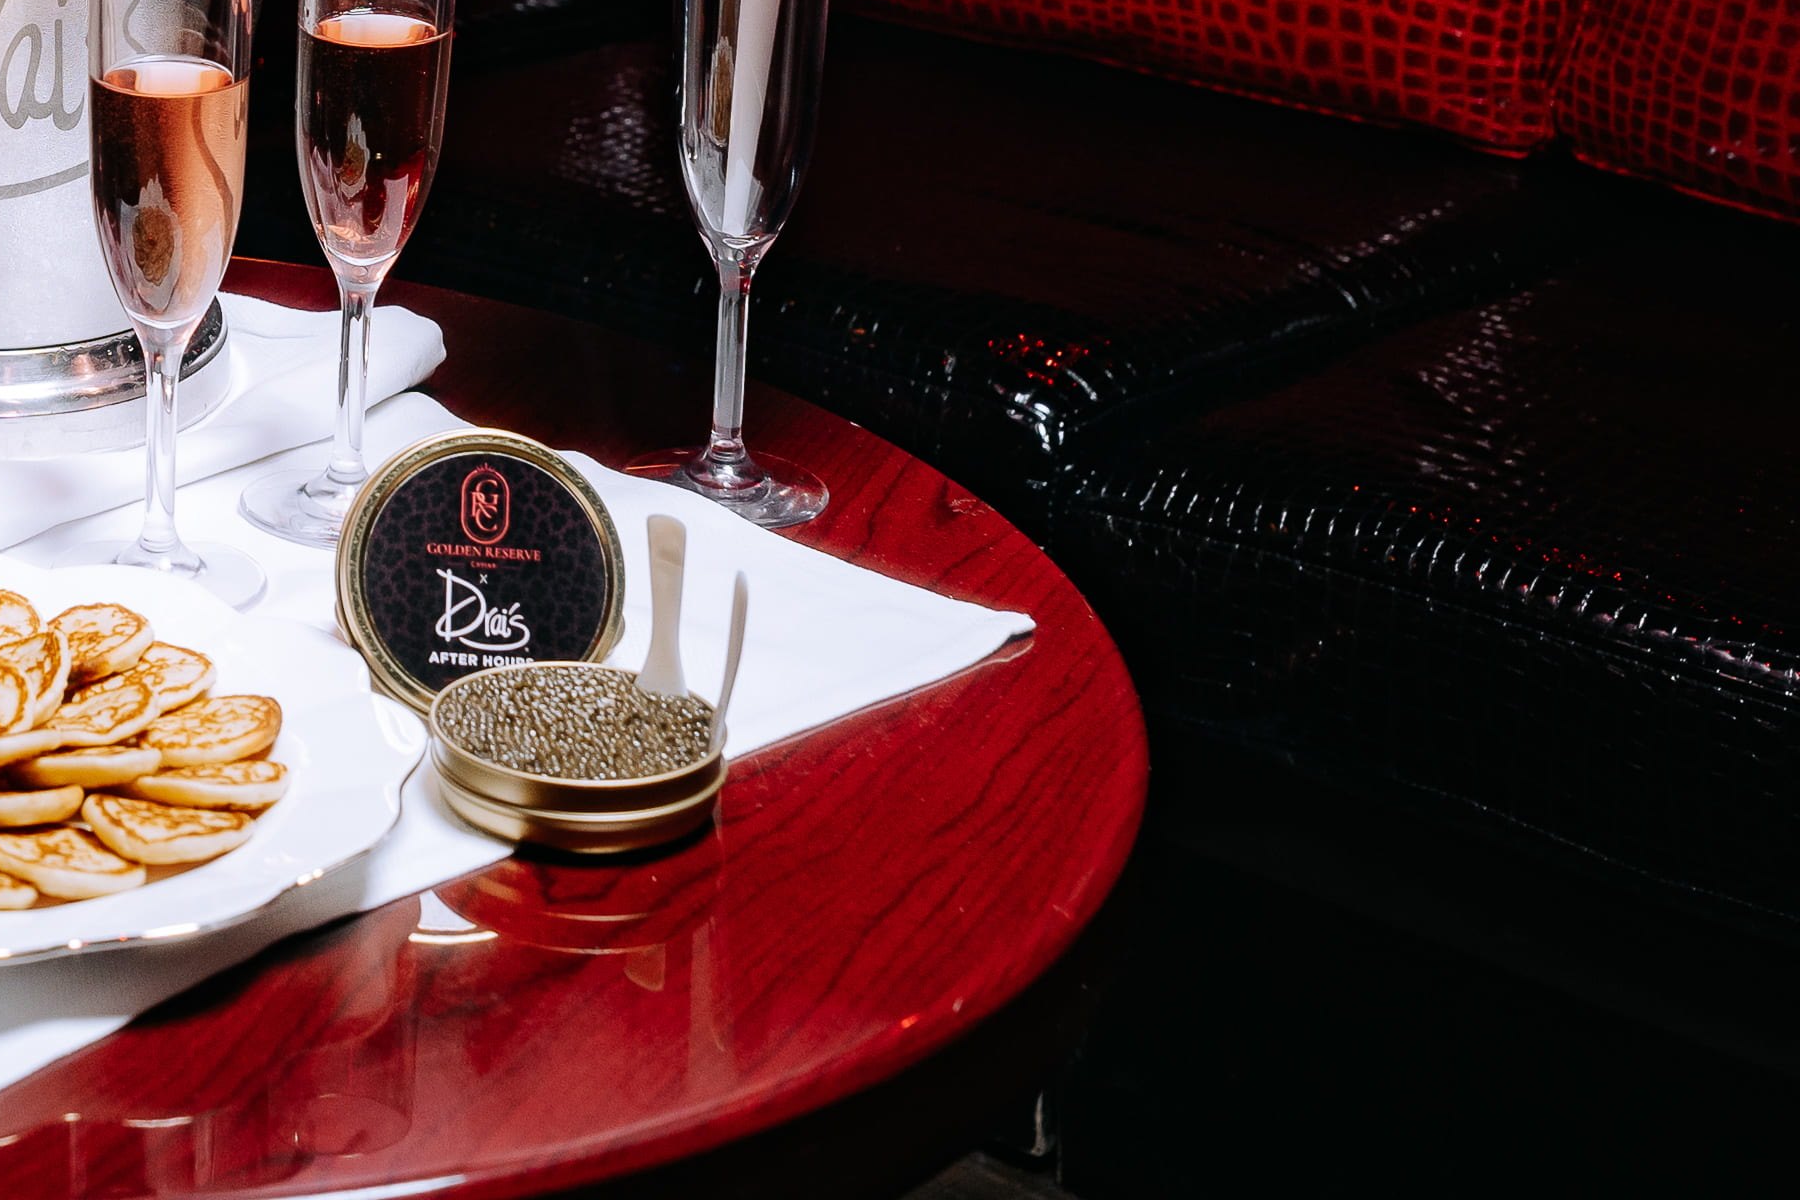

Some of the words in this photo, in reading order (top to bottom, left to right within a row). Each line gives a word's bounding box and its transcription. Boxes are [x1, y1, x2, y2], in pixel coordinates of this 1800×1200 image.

[426, 542, 482, 557] GOLDEN
[485, 546, 542, 562] RESERVE
[435, 569, 531, 651] Drai's
[428, 651, 479, 667] AFTER
